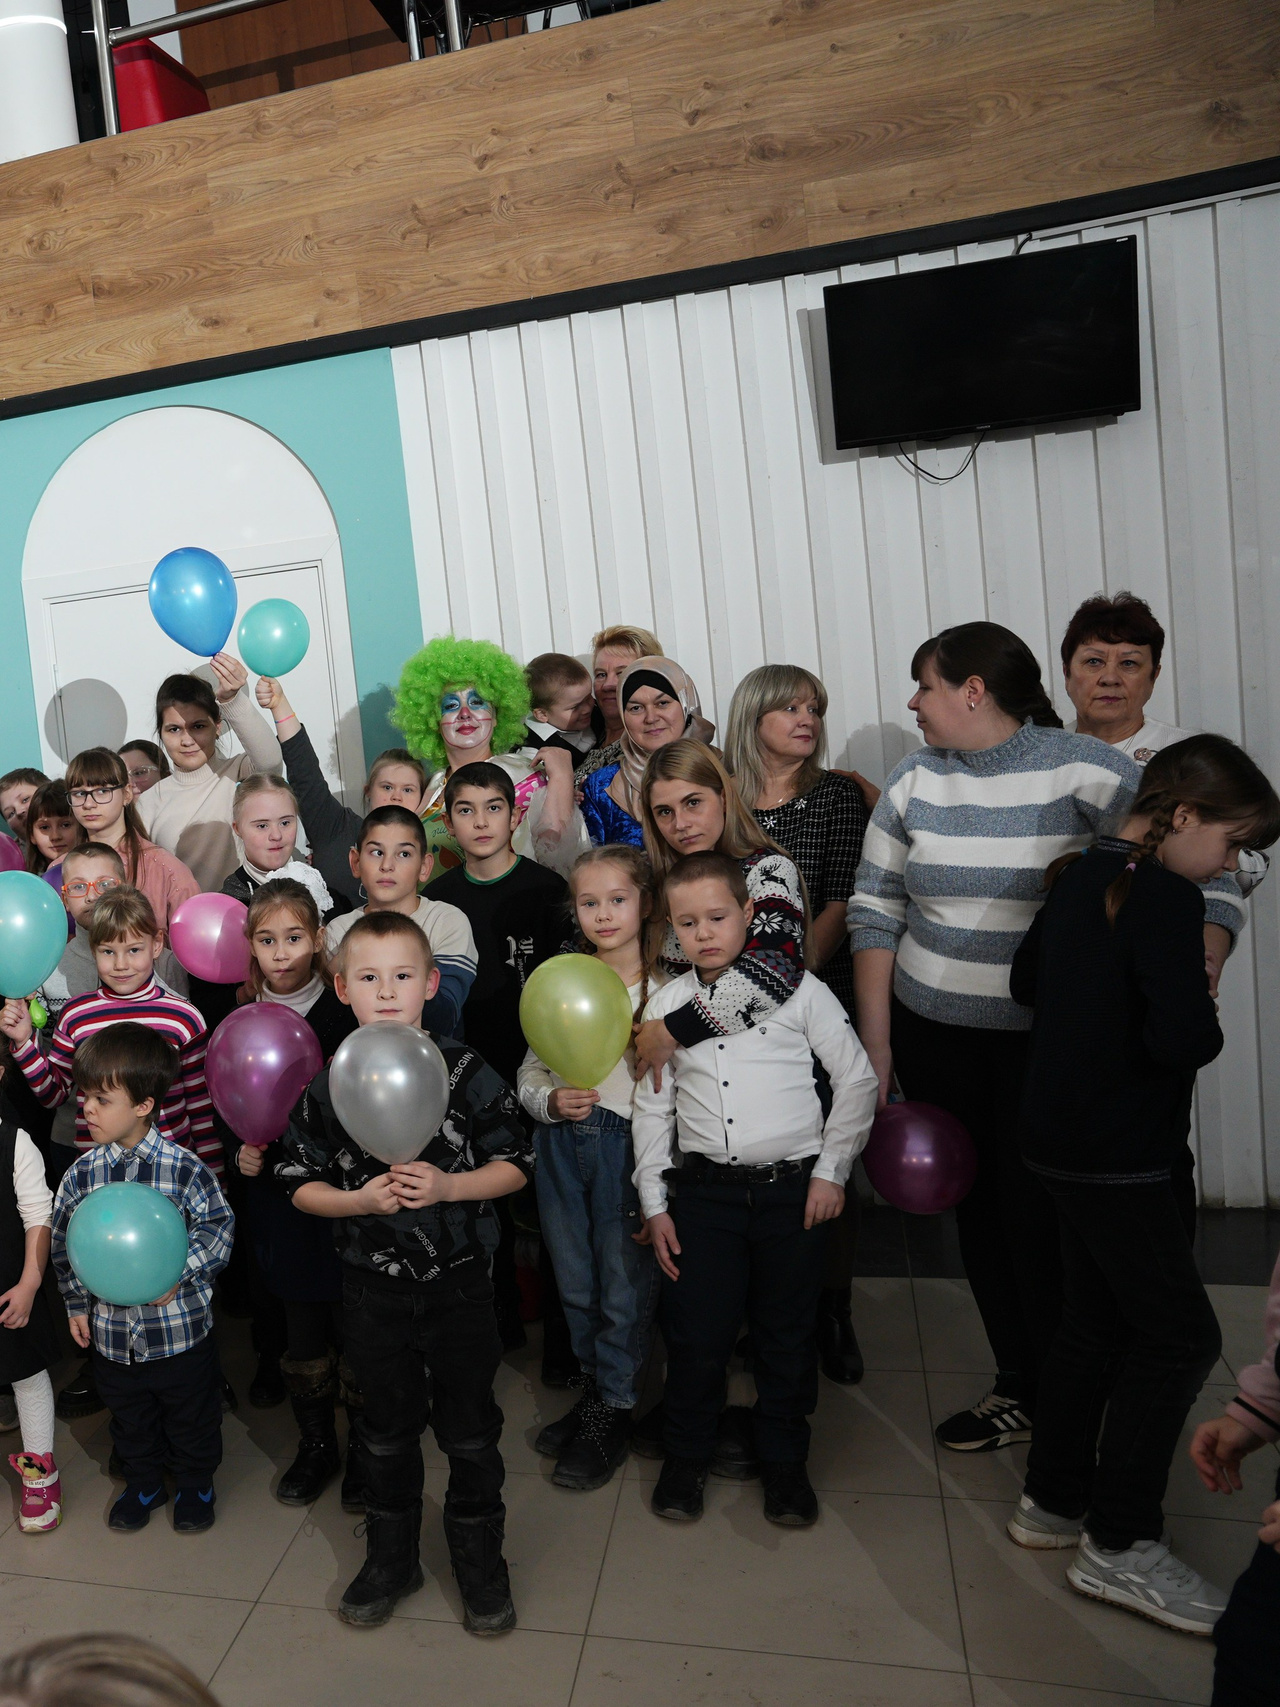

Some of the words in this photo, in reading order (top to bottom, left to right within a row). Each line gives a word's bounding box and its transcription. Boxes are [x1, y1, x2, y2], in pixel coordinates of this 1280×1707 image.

[449, 1051, 475, 1090] DESGIN
[412, 1226, 437, 1257] DESGIN
[422, 1264, 441, 1282] GIN
